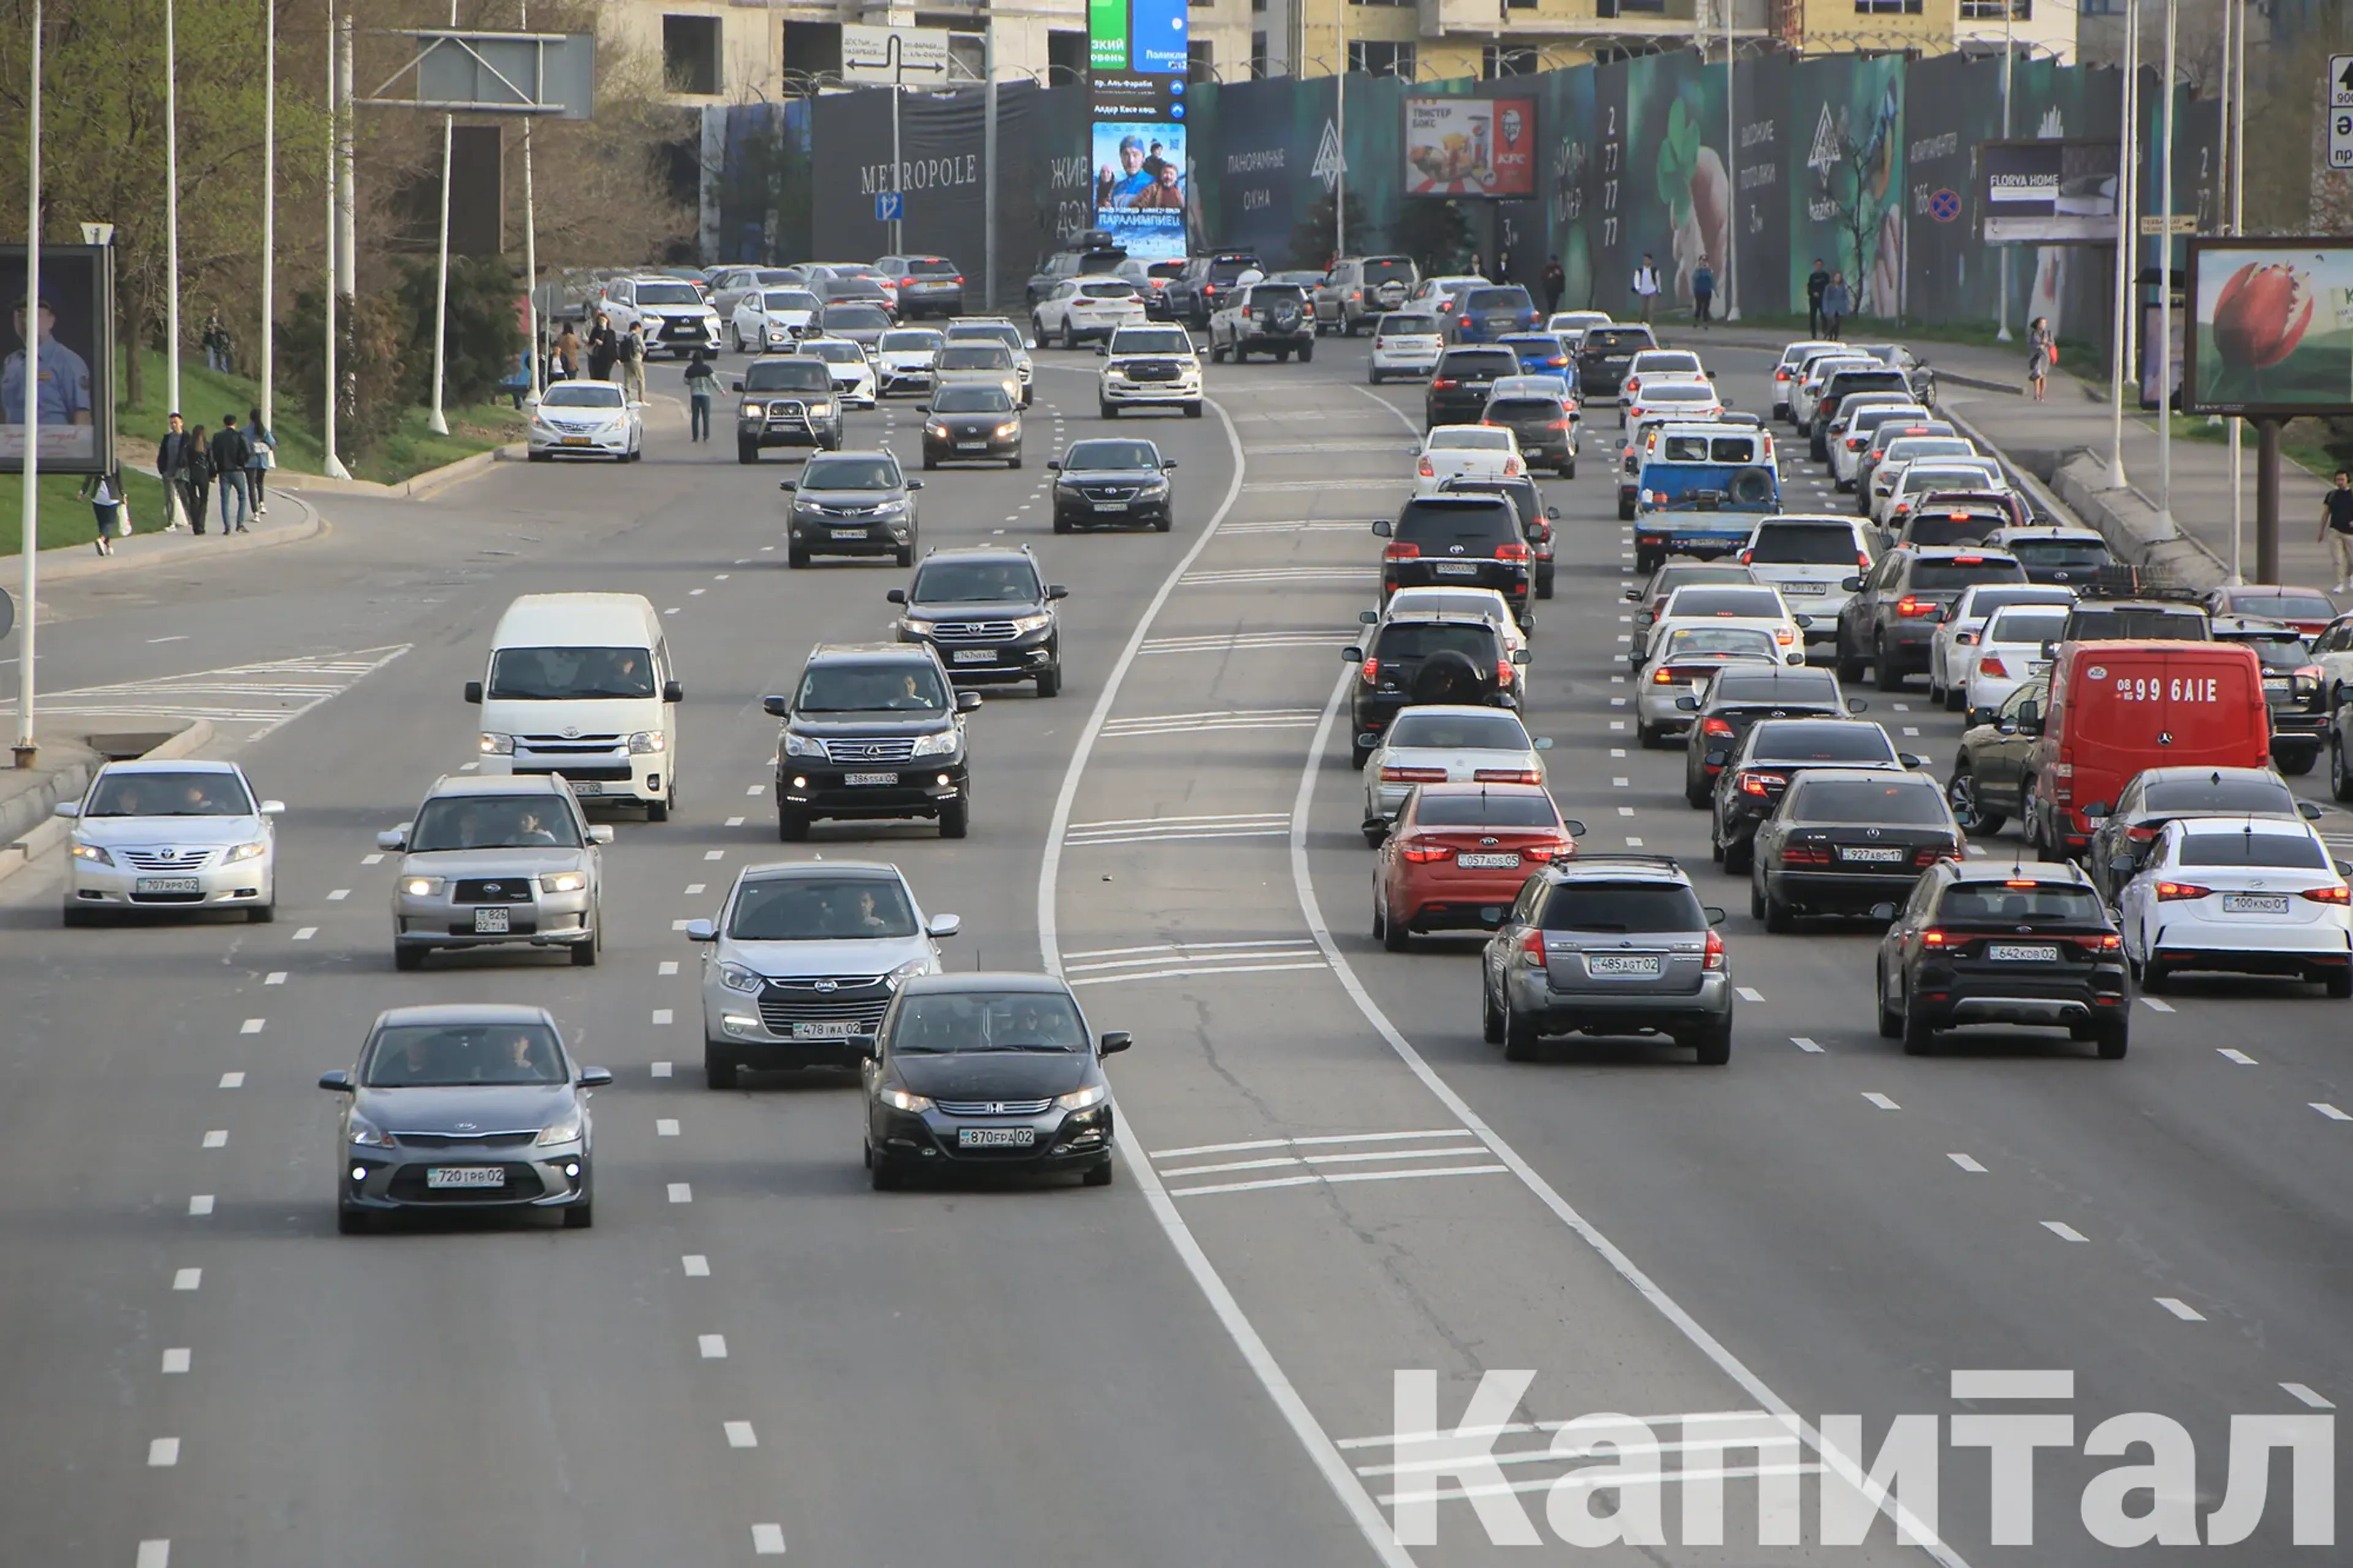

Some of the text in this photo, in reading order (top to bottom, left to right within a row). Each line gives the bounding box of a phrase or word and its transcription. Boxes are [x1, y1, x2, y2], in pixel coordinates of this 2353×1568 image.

[1496, 154, 1526, 165] KFC
[2029, 174, 2059, 186] HOME
[2117, 679, 2131, 691] 08
[1467, 855, 1485, 865] 057
[147, 881, 165, 890] 707
[186, 880, 197, 890] 02
[1999, 949, 2019, 958] 642
[2042, 949, 2055, 959] 02
[1601, 959, 1621, 969] 485
[1623, 961, 1642, 970] AGT
[1643, 958, 1658, 969] 02
[803, 1024, 824, 1035] 478
[846, 1023, 860, 1034] 02
[971, 1131, 993, 1143] 870
[1018, 1130, 1033, 1143] 02
[439, 1170, 461, 1183] 720
[488, 1169, 504, 1182] 02
